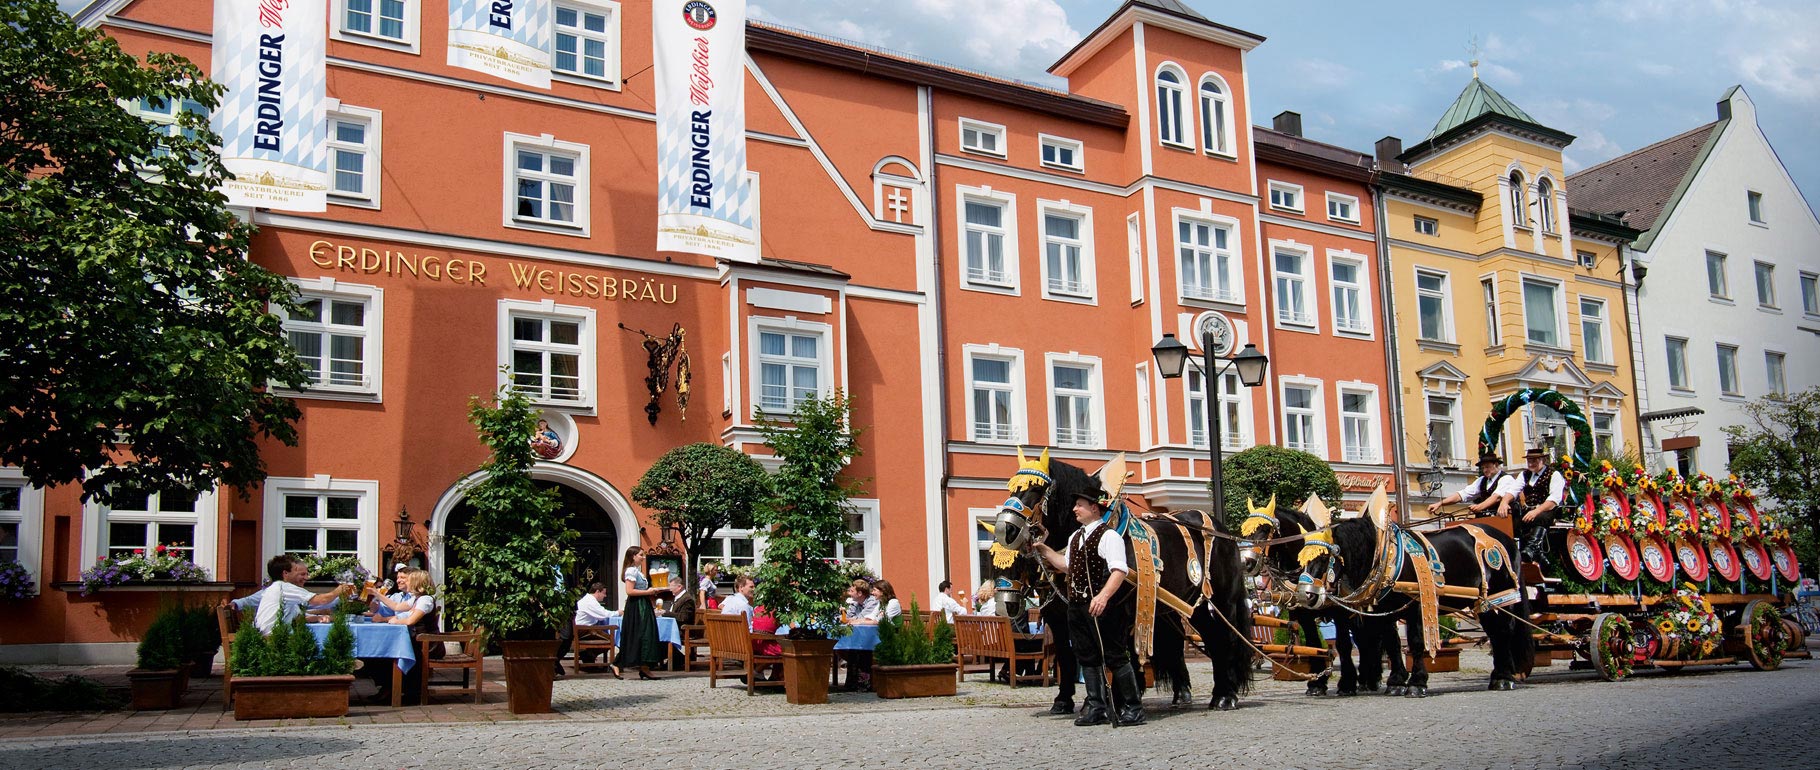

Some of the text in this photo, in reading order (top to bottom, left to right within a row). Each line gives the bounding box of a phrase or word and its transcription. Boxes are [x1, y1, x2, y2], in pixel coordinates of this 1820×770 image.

[489, 0, 513, 30] ER
[686, 1, 713, 16] ERDINGER
[469, 52, 533, 72] PRIVATBRAUEREI
[254, 33, 285, 152] ERDINGER
[690, 37, 714, 209] ERDINGER Weißbier
[228, 184, 304, 197] PRIVATBRAUEREI
[309, 240, 678, 304] ERDINGER WEISSBRÄU
